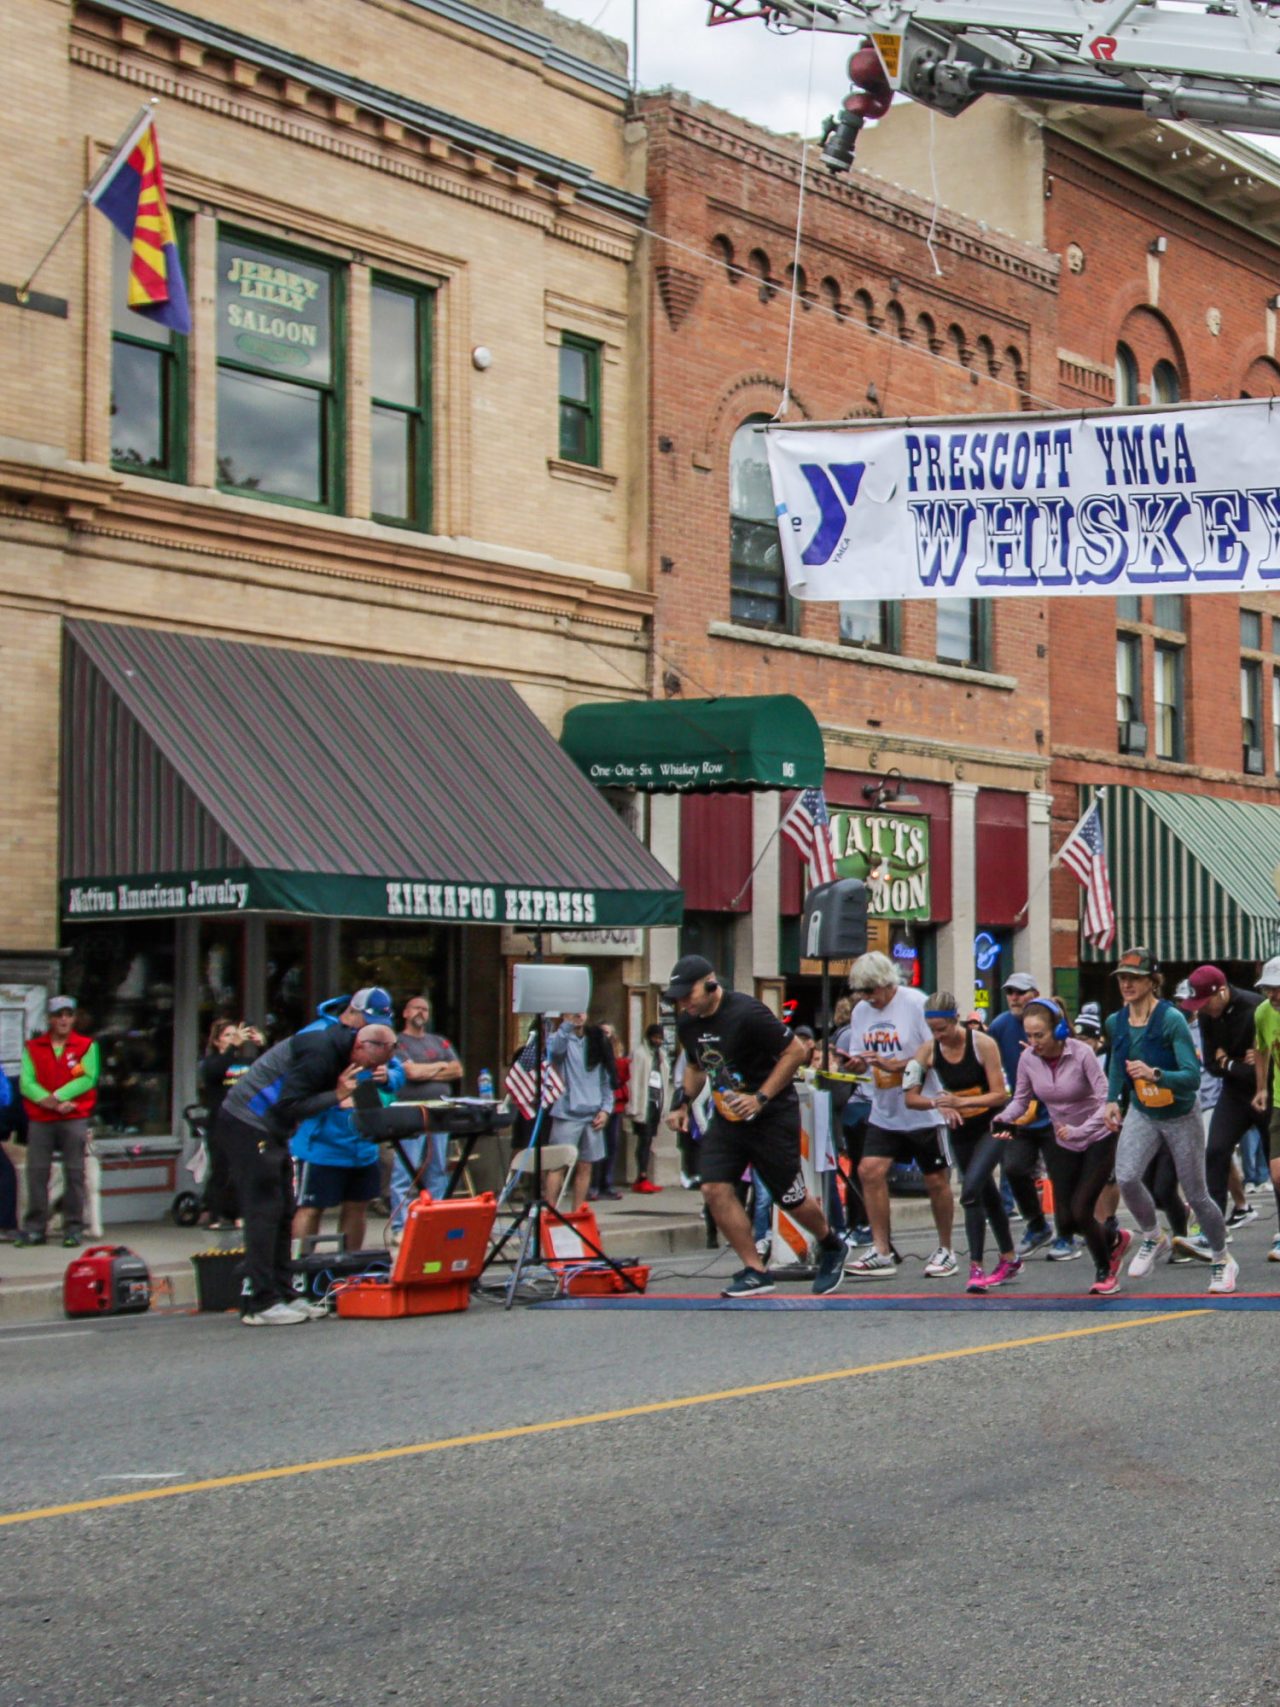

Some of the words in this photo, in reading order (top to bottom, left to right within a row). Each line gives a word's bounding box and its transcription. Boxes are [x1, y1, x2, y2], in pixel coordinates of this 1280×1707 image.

[227, 257, 319, 300] JERSEY
[239, 279, 309, 312] LILLY
[227, 303, 318, 347] SALOON
[905, 428, 1073, 493] PRESCOTT
[1094, 422, 1198, 487] YMCA
[832, 536, 852, 565] YMCA
[659, 762, 700, 779] Whiskey
[702, 761, 723, 775] Row
[68, 886, 117, 913] Native
[117, 883, 186, 911] American
[187, 877, 249, 909] Jewelry
[386, 882, 497, 920] KIKKAPOO
[504, 889, 597, 924] EXPRESS
[867, 871, 928, 914] OON
[862, 1030, 903, 1053] WRM
